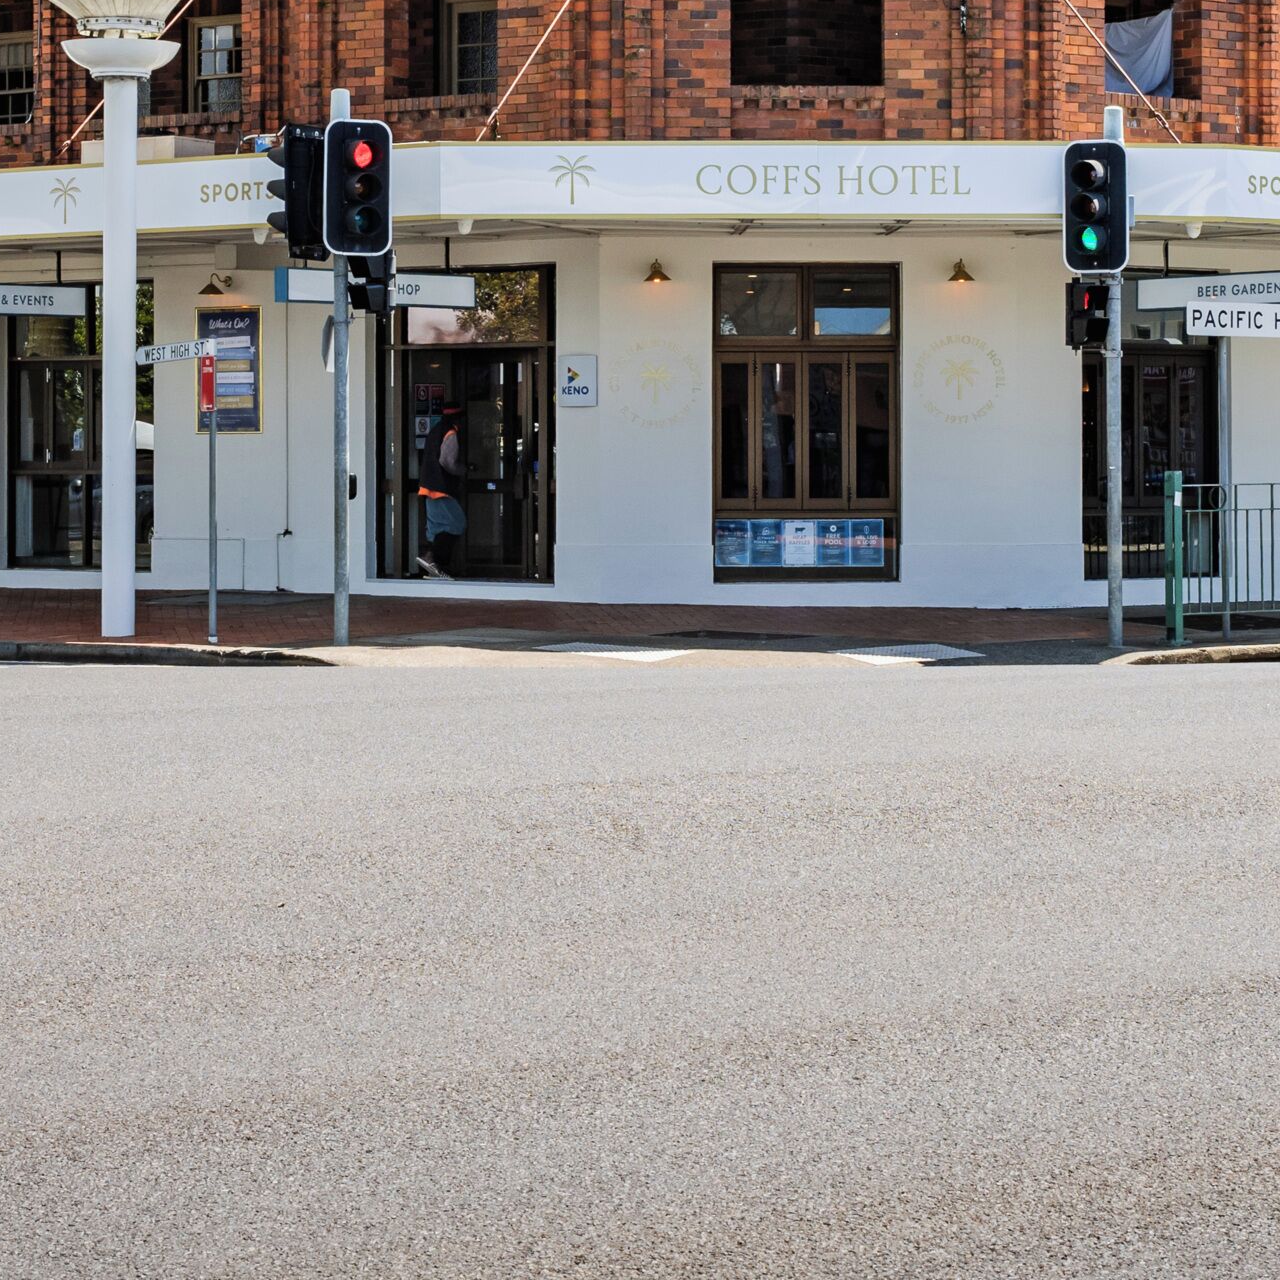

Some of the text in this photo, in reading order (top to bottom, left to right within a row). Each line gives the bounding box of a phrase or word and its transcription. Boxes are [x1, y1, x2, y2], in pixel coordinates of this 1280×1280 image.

[695, 164, 971, 196] COFFS HOTEL
[397, 283, 421, 296] HOP
[1197, 285, 1227, 297] BEER
[1, 294, 9, 305] &
[13, 294, 54, 306] EVENTS
[1192, 309, 1264, 329] PACIFIC
[144, 341, 205, 362] WEST HIGH ST
[561, 385, 590, 395] KENO
